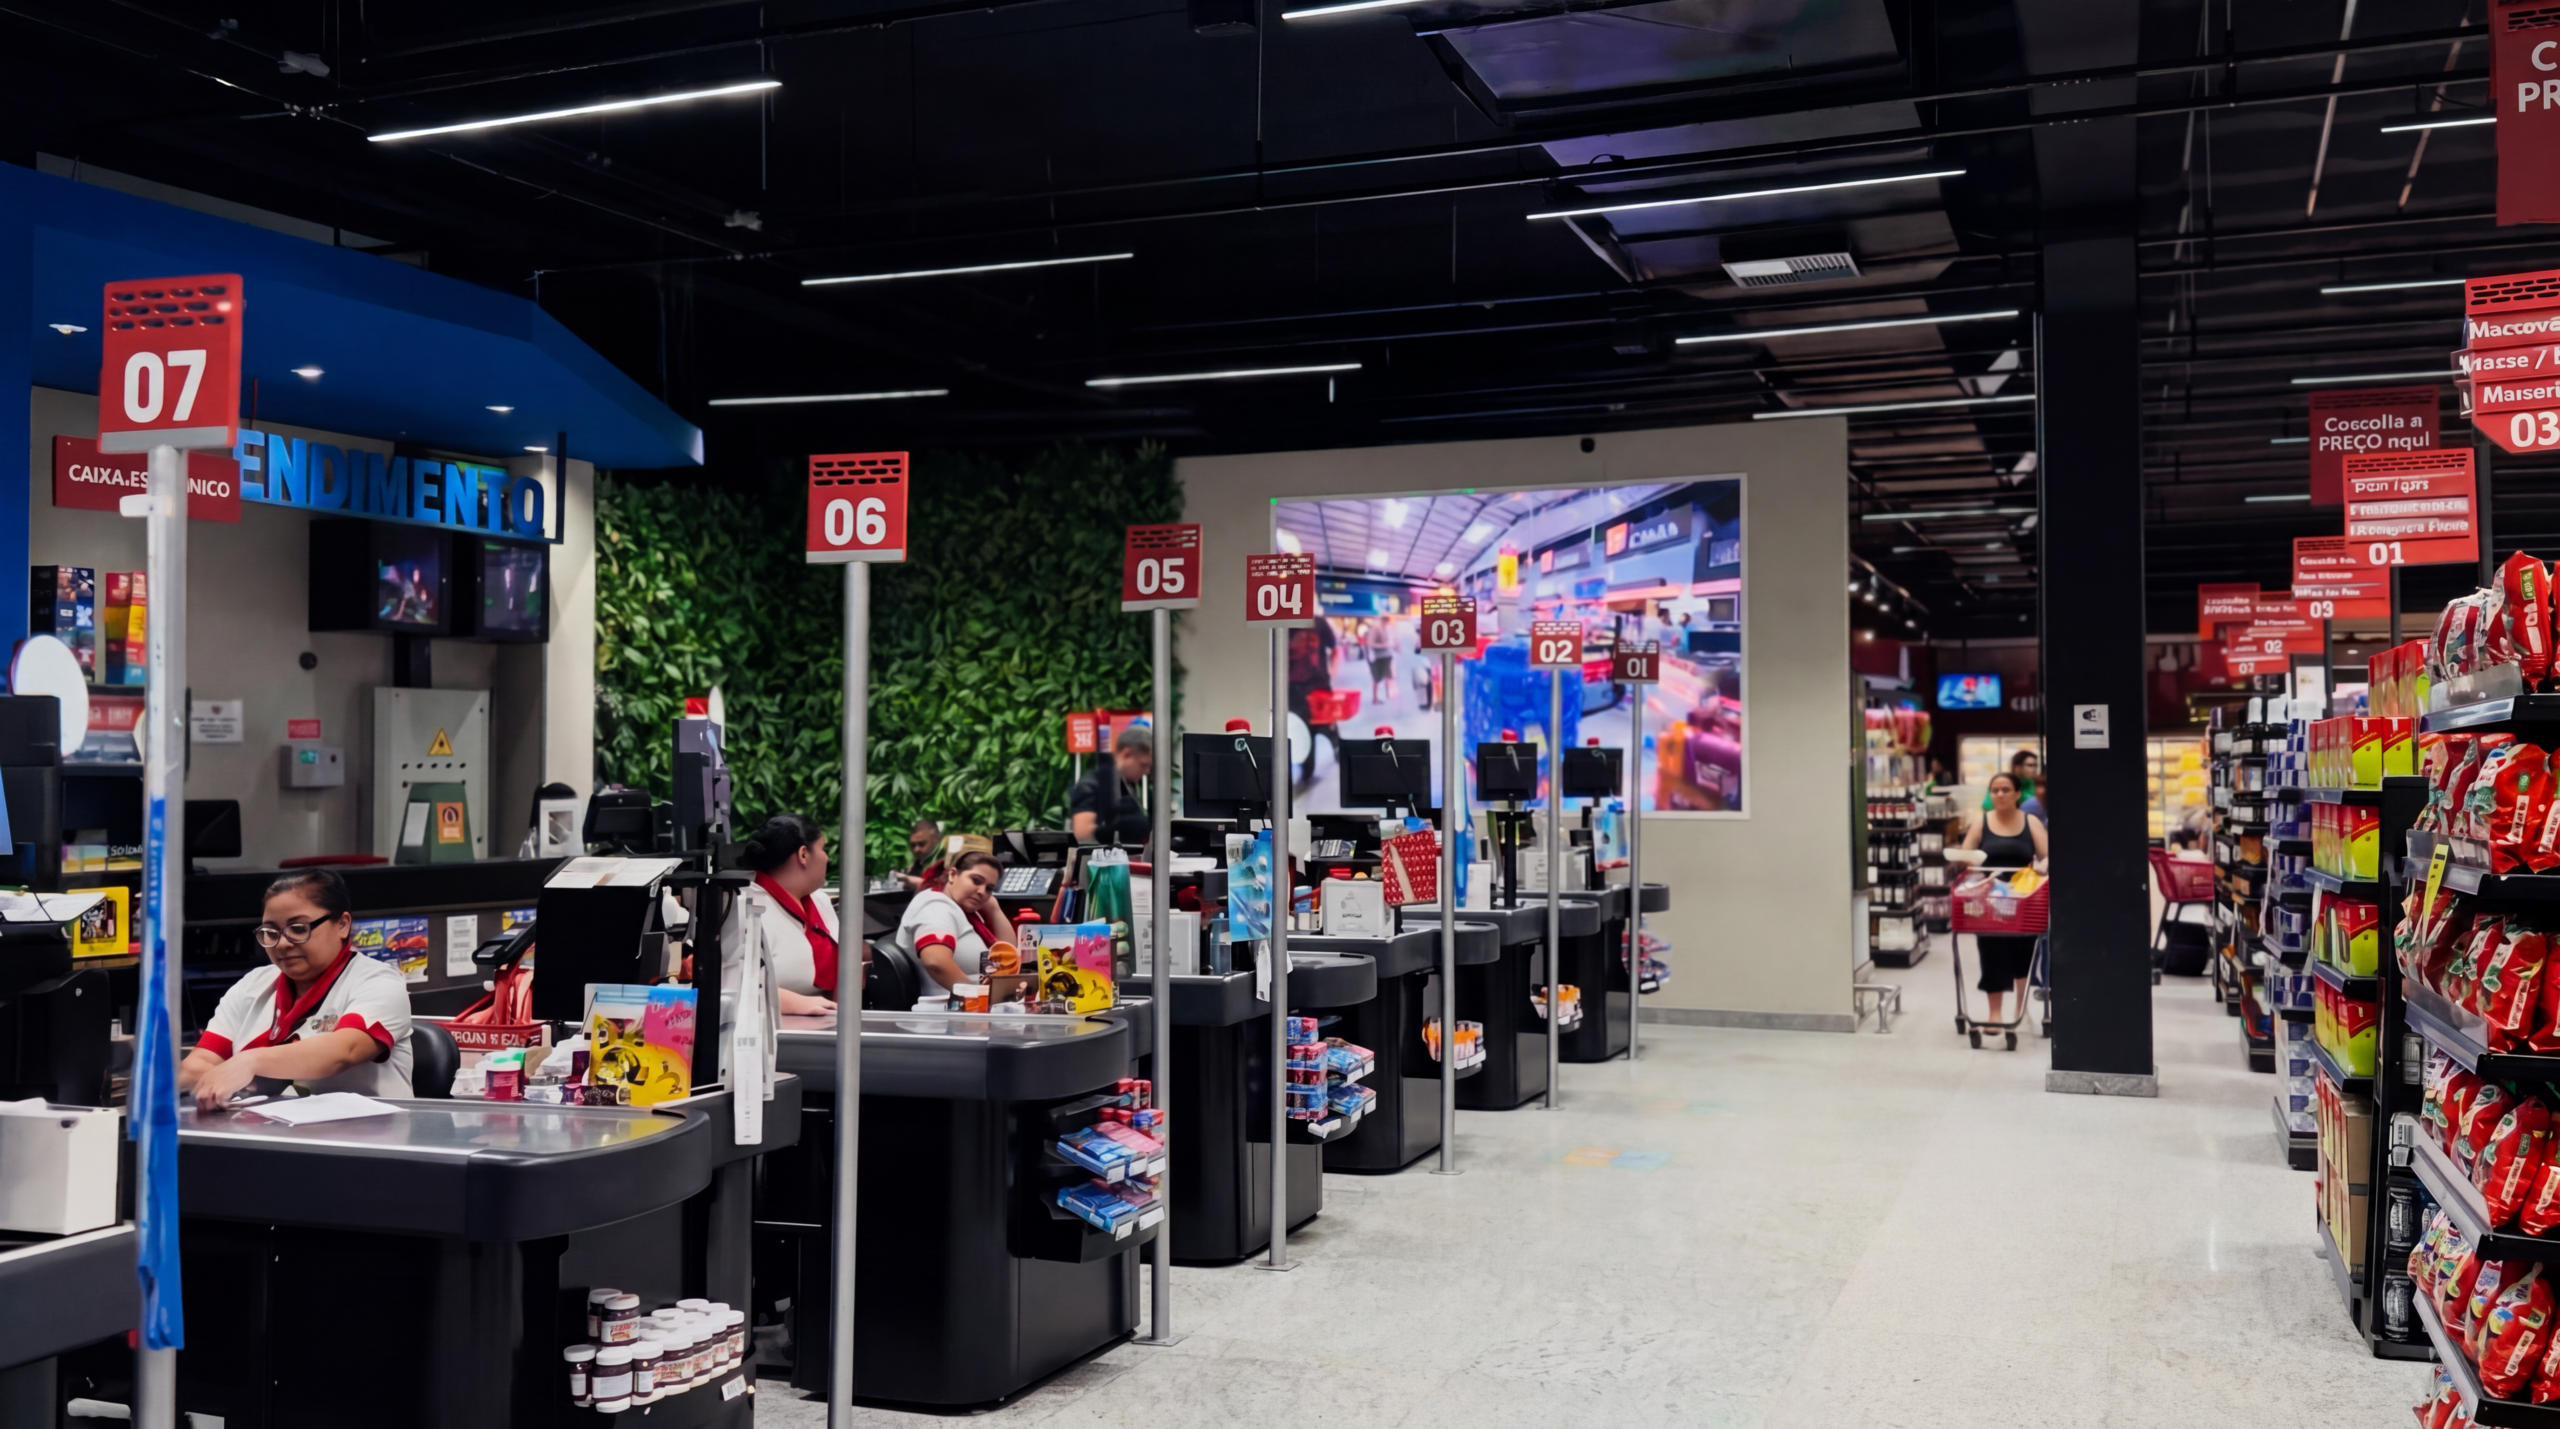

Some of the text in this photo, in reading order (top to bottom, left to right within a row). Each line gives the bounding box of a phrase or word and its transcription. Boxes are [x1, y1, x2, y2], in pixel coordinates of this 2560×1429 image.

[123, 349, 208, 424] 07
[2319, 433, 2383, 454] PREÇO
[2510, 411, 2560, 448] 03
[823, 496, 887, 547] 06
[2368, 541, 2405, 566] 01
[1136, 557, 1186, 596] 05
[1256, 583, 1303, 617] 04
[1430, 618, 1466, 646] 03
[2263, 640, 2283, 654] 02
[1539, 639, 1574, 663] 02
